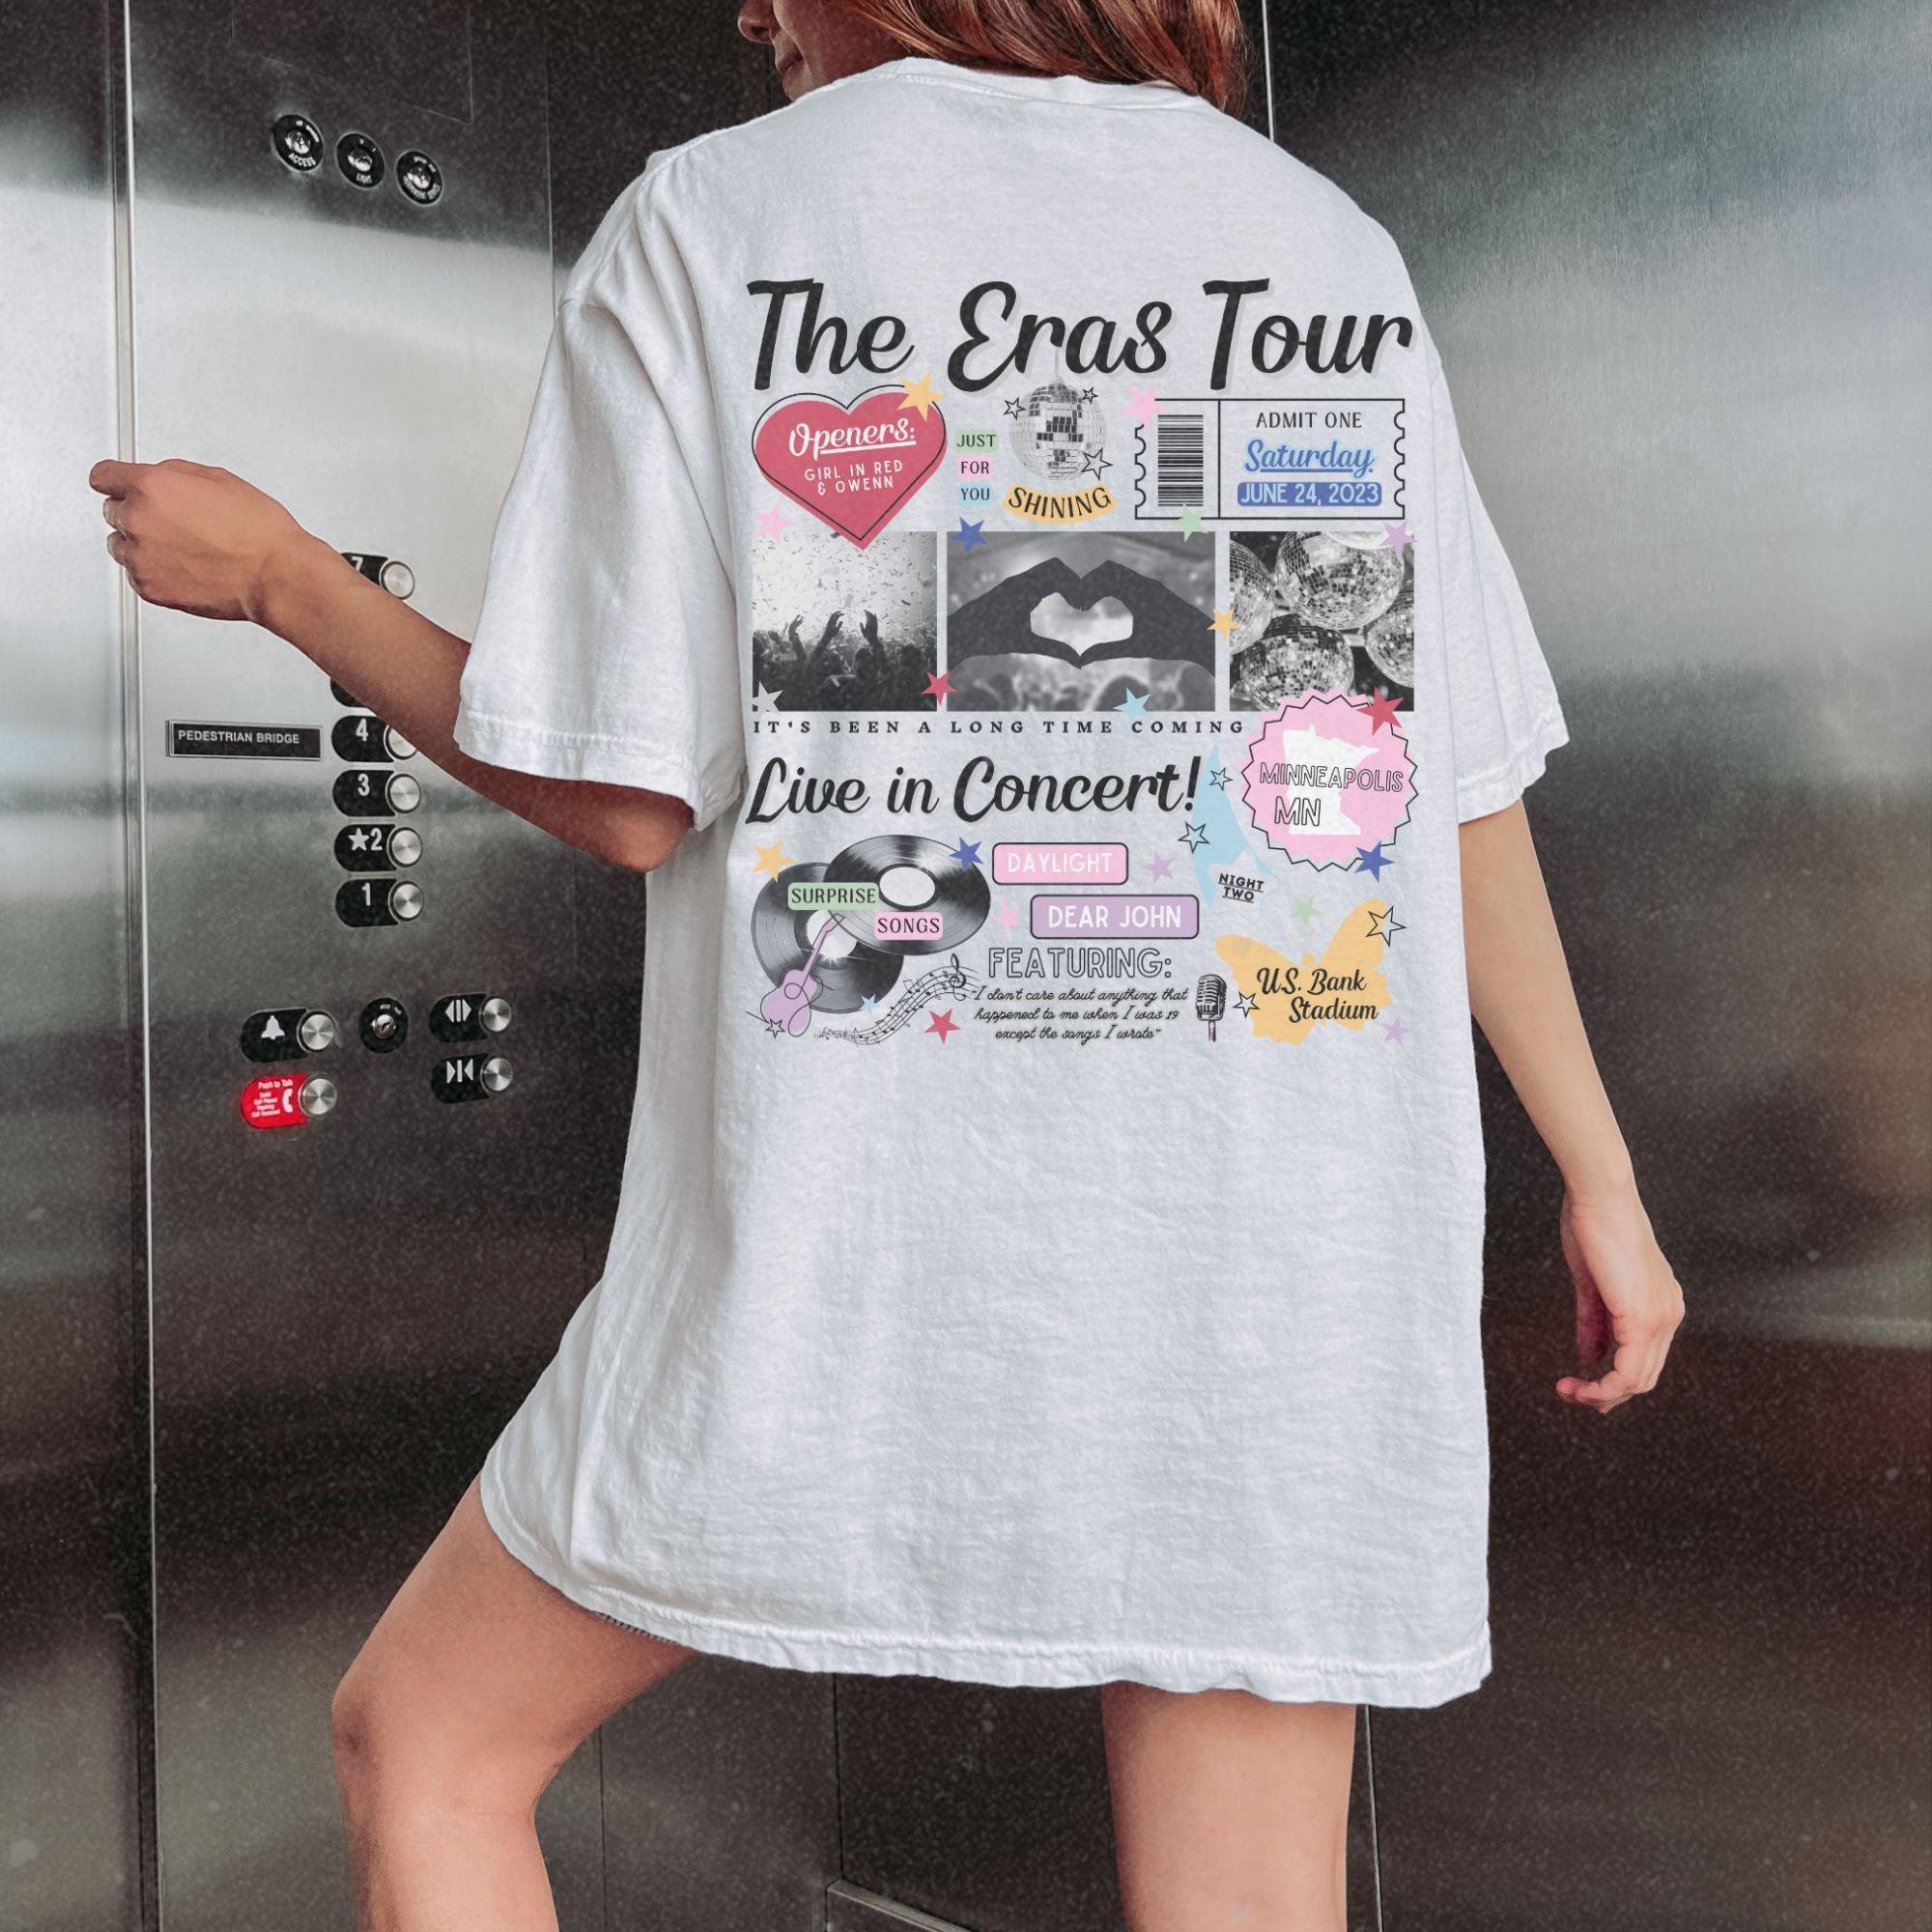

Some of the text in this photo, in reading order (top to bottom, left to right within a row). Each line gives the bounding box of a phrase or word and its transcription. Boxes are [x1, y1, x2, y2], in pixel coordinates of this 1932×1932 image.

[747, 278, 1413, 392] The Eras Tour
[1256, 412, 1362, 428] ADMIT ONE
[789, 418, 916, 461] Openers:
[956, 435, 996, 447] JUST
[805, 459, 903, 481] GIRL IN RED
[960, 461, 989, 473] FOR
[817, 476, 894, 496] & OWENN
[960, 488, 990, 500] YOU
[1240, 483, 1378, 506] JUNE 24, 2023
[1009, 487, 1111, 518] SHINING
[352, 556, 363, 572] 7
[178, 729, 299, 744] PEDESTRIAN BRIDGE
[355, 719, 369, 742] 4
[753, 721, 1243, 733] IT'S BEEN A LONG TIME COMING
[357, 774, 370, 796] 3
[1259, 762, 1404, 792] MINNEAPOLIS
[745, 755, 1202, 824] Live in Concert!
[1274, 796, 1321, 826] MN
[370, 828, 383, 851] 2
[1008, 852, 1113, 873] DAYLIGHT
[1218, 873, 1264, 892] NIGHT
[361, 882, 371, 906] 1
[791, 887, 877, 904] SURPRISE
[1222, 886, 1255, 902] TWO
[877, 917, 940, 934] SONGS
[1048, 904, 1181, 928] DEAR JOHN
[988, 947, 1172, 979] FEATURING:
[1257, 968, 1368, 994] U.S. Bank
[986, 988, 1022, 1001] don't
[1025, 991, 1055, 1001] care
[1058, 987, 1094, 1001] about
[1097, 987, 1157, 1007] anything
[1161, 988, 1189, 1001] that
[974, 1008, 1040, 1023] happened
[1042, 1008, 1056, 1020] to
[1083, 1008, 1119, 1020] when
[1122, 1005, 1135, 1019] I
[1134, 1009, 1163, 1020] was
[1165, 1010, 1179, 1020] 19
[1288, 996, 1378, 1024] Stadium
[995, 1027, 1036, 1045] except
[1039, 1027, 1059, 1039] the
[1063, 1031, 1101, 1045] songs
[1104, 1024, 1117, 1039] I
